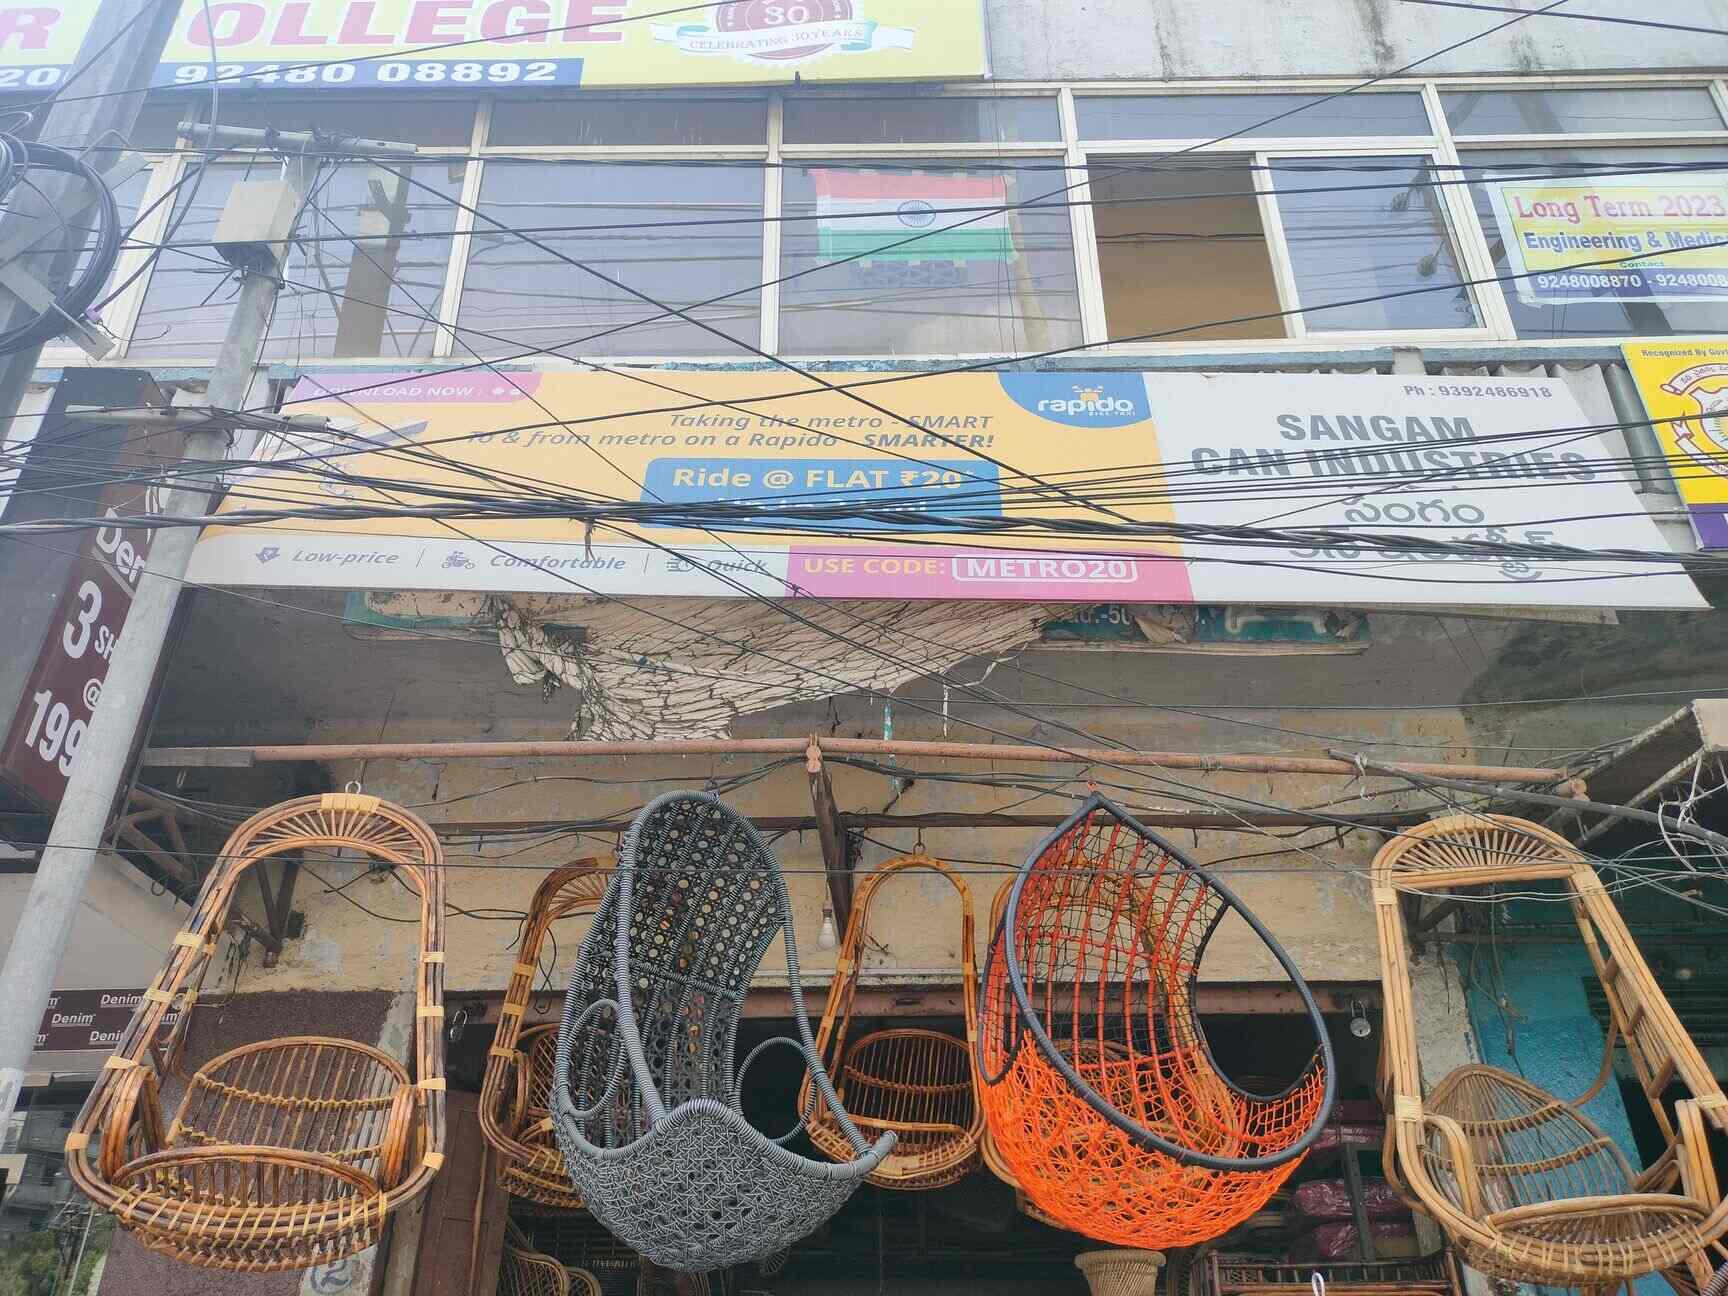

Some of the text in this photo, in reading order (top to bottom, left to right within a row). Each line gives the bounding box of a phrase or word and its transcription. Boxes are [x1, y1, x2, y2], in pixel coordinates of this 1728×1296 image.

[186, 0, 629, 47] OLLEGE
[689, 36, 788, 50] CELEBRATING
[174, 63, 355, 85] 92480
[376, 61, 558, 82] 08892
[1514, 195, 1727, 224] Long Term 2023
[1523, 231, 1642, 253] Engineering
[1647, 230, 1662, 248] &
[1620, 260, 1665, 269] Contact
[1537, 274, 1642, 290] 9248008870
[313, 386, 475, 398] DOWNLOAD NOW
[1438, 384, 1553, 398] 9392486918
[1037, 396, 1134, 416] rapido
[670, 414, 748, 432] Taking
[759, 414, 799, 428] the
[808, 415, 883, 428] metro
[907, 415, 995, 429] SMART
[1276, 413, 1476, 442] SANGAM
[501, 430, 520, 445] &
[523, 431, 592, 448] from
[599, 434, 678, 446] metro
[685, 434, 717, 446] on
[725, 434, 739, 446] a
[749, 433, 838, 449] Rapido
[863, 433, 995, 448] SMARTER!
[1190, 447, 1596, 481] CAN INDUSTRIES
[671, 468, 752, 488] Ride
[763, 469, 794, 489] @
[806, 469, 889, 489] FLAT
[291, 549, 768, 573] Low-price Comfortable Quick
[803, 557, 1128, 579] USE CODE: METRO20
[62, 580, 103, 659] 3
[100, 992, 143, 1006] Denim
[51, 1012, 95, 1025] Denim
